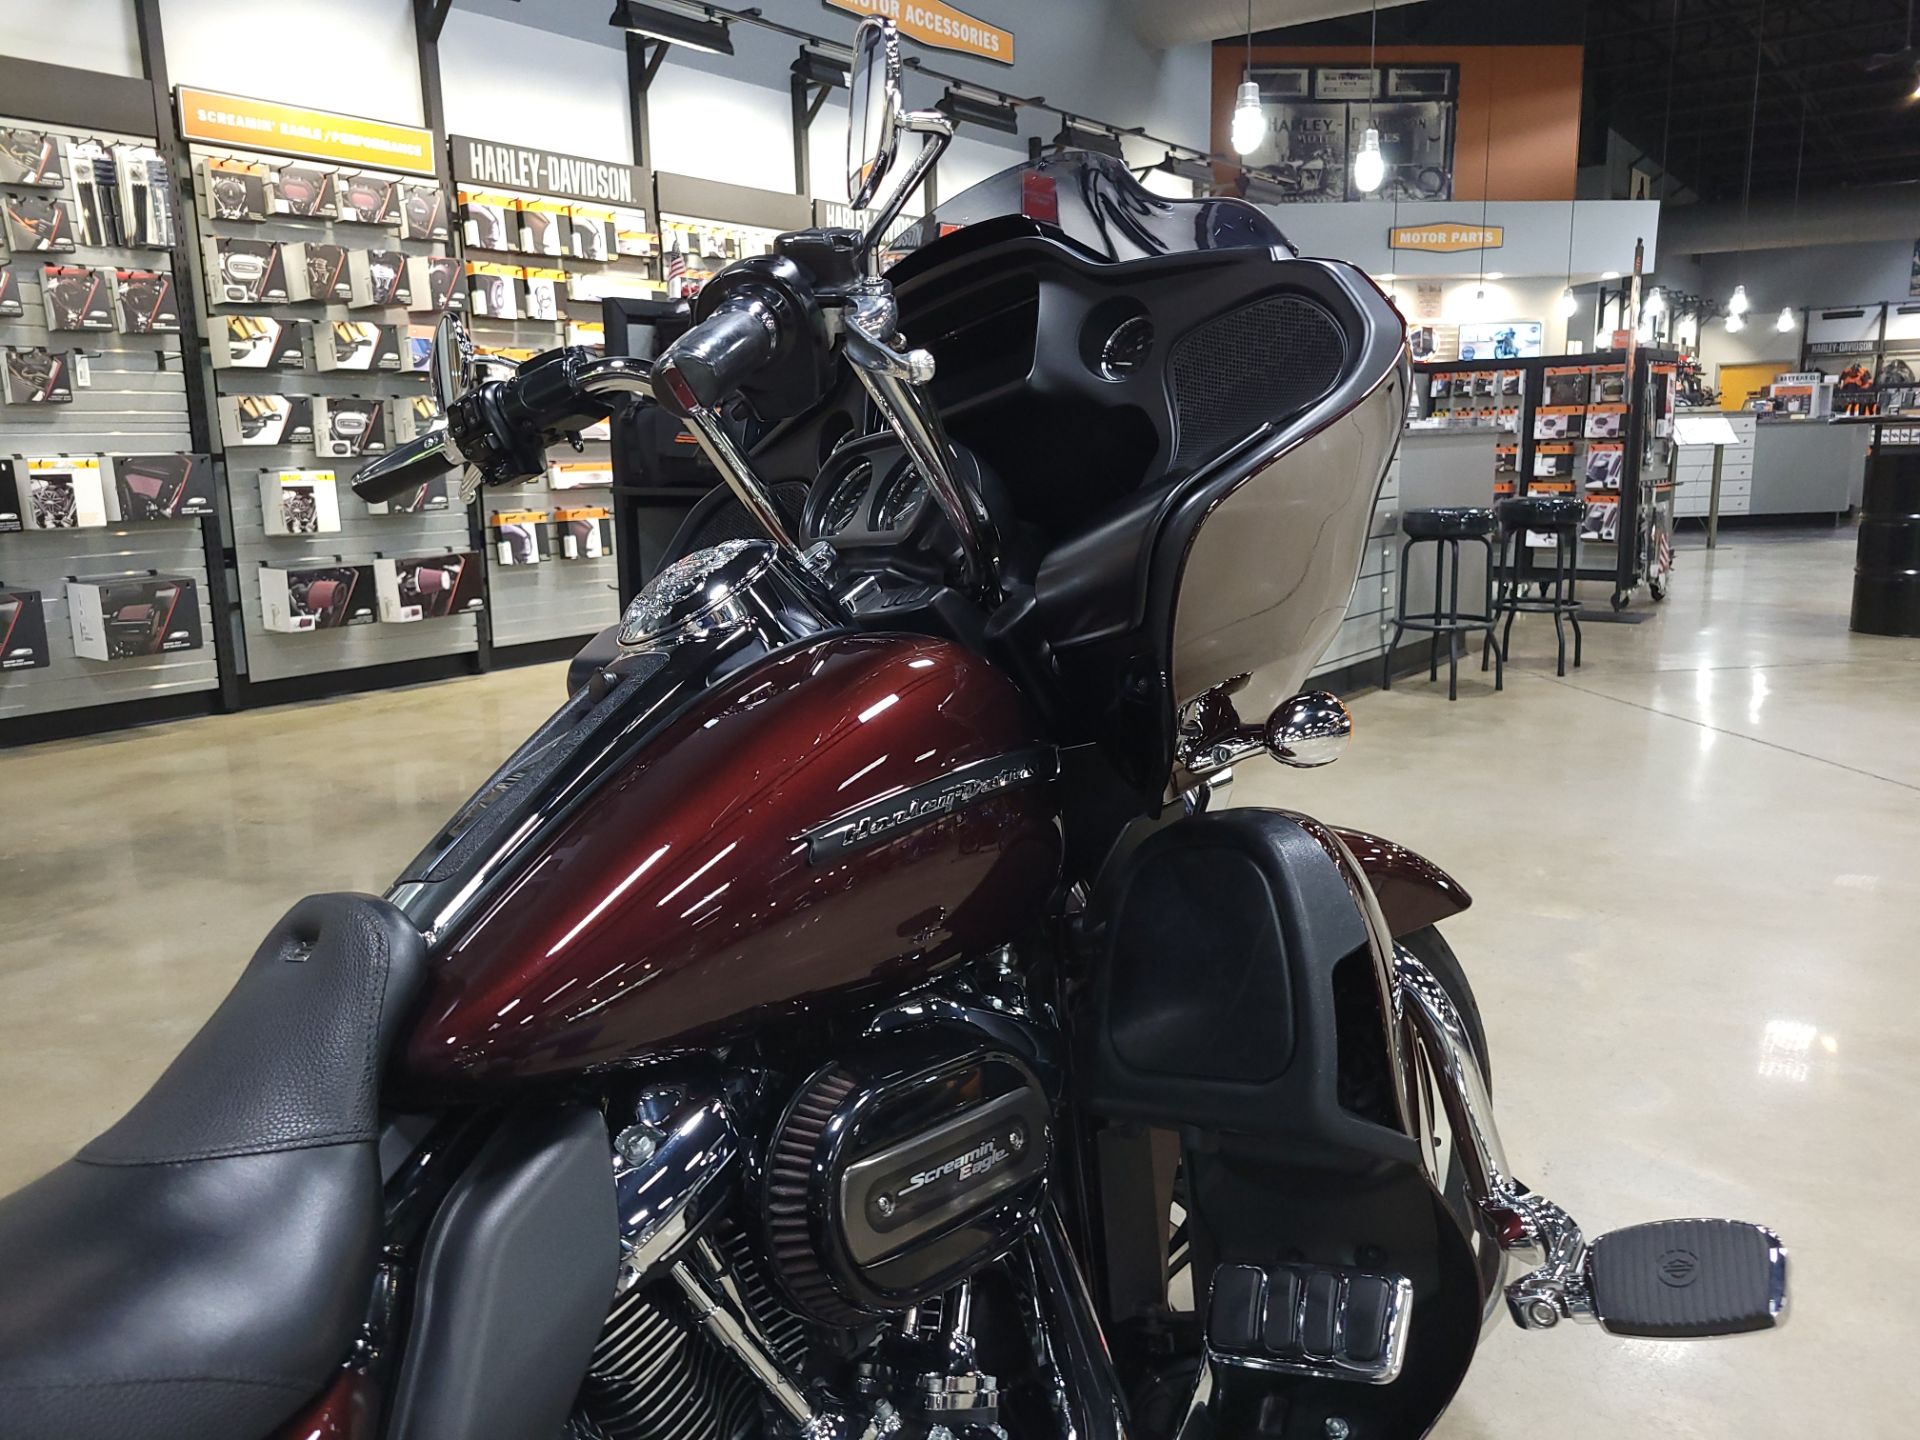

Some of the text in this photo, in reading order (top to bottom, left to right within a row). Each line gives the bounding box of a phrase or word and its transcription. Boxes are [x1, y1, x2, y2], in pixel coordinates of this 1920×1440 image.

[905, 4, 999, 52] ACCESSORIES
[469, 142, 632, 202] HARLEY-DAVIDSON
[1400, 232, 1493, 244] MOTOR PARTS
[959, 1149, 1010, 1181] Eagle
